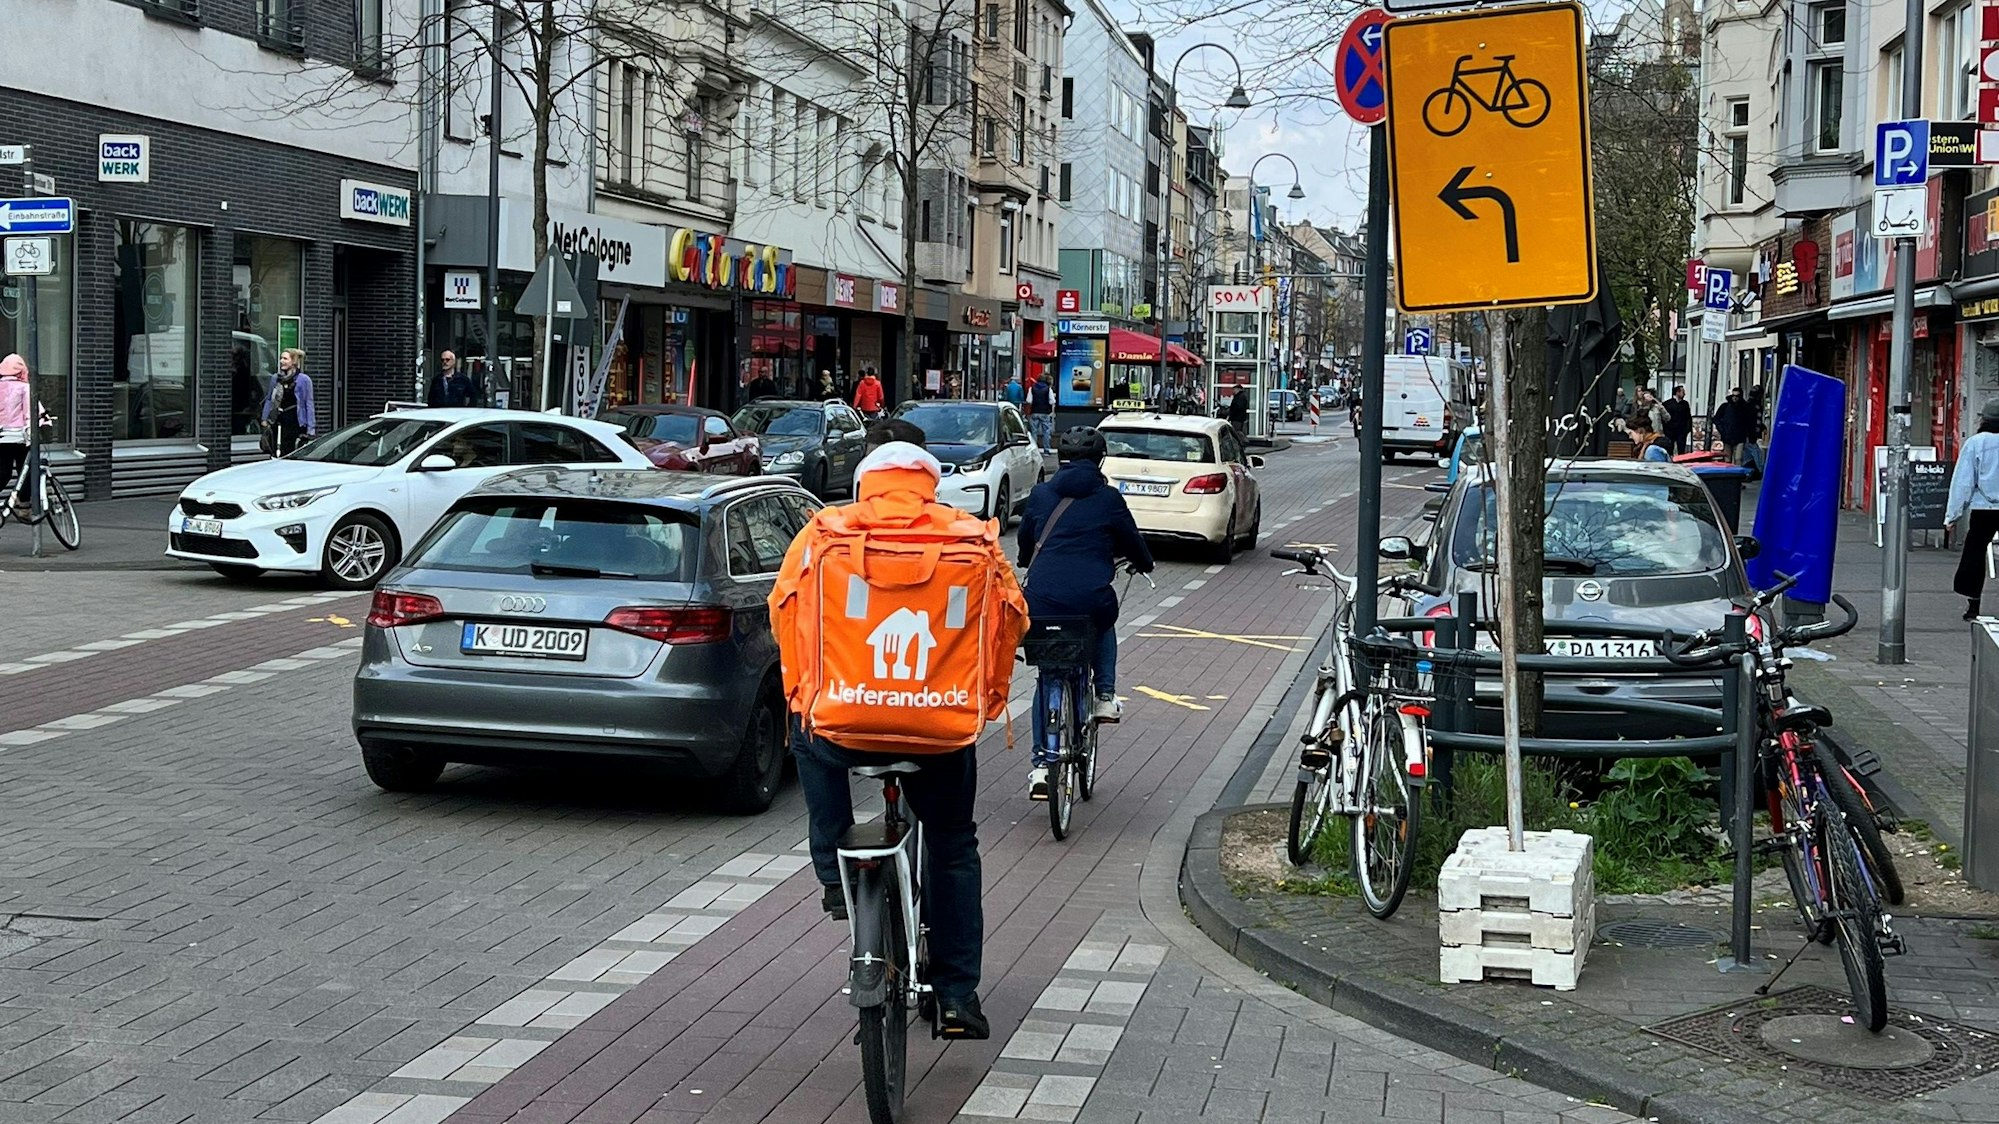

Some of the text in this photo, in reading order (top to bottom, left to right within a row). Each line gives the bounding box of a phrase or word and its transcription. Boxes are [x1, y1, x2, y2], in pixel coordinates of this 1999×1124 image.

[103, 144, 138, 157] back
[1883, 129, 1913, 178] P
[1930, 144, 1959, 153] Union
[102, 162, 139, 175] WERK
[8, 212, 66, 220] Einbahnstraße
[553, 221, 632, 272] NetCologne
[1215, 285, 1263, 306] SONY
[1708, 273, 1724, 304] P
[1059, 321, 1108, 332] U Körnerstr.
[1229, 341, 1244, 356] U
[1148, 485, 1169, 493] 9807
[475, 626, 583, 651] K UD 2009
[1570, 642, 1595, 657] PA
[827, 679, 969, 708] Lieferando.de
